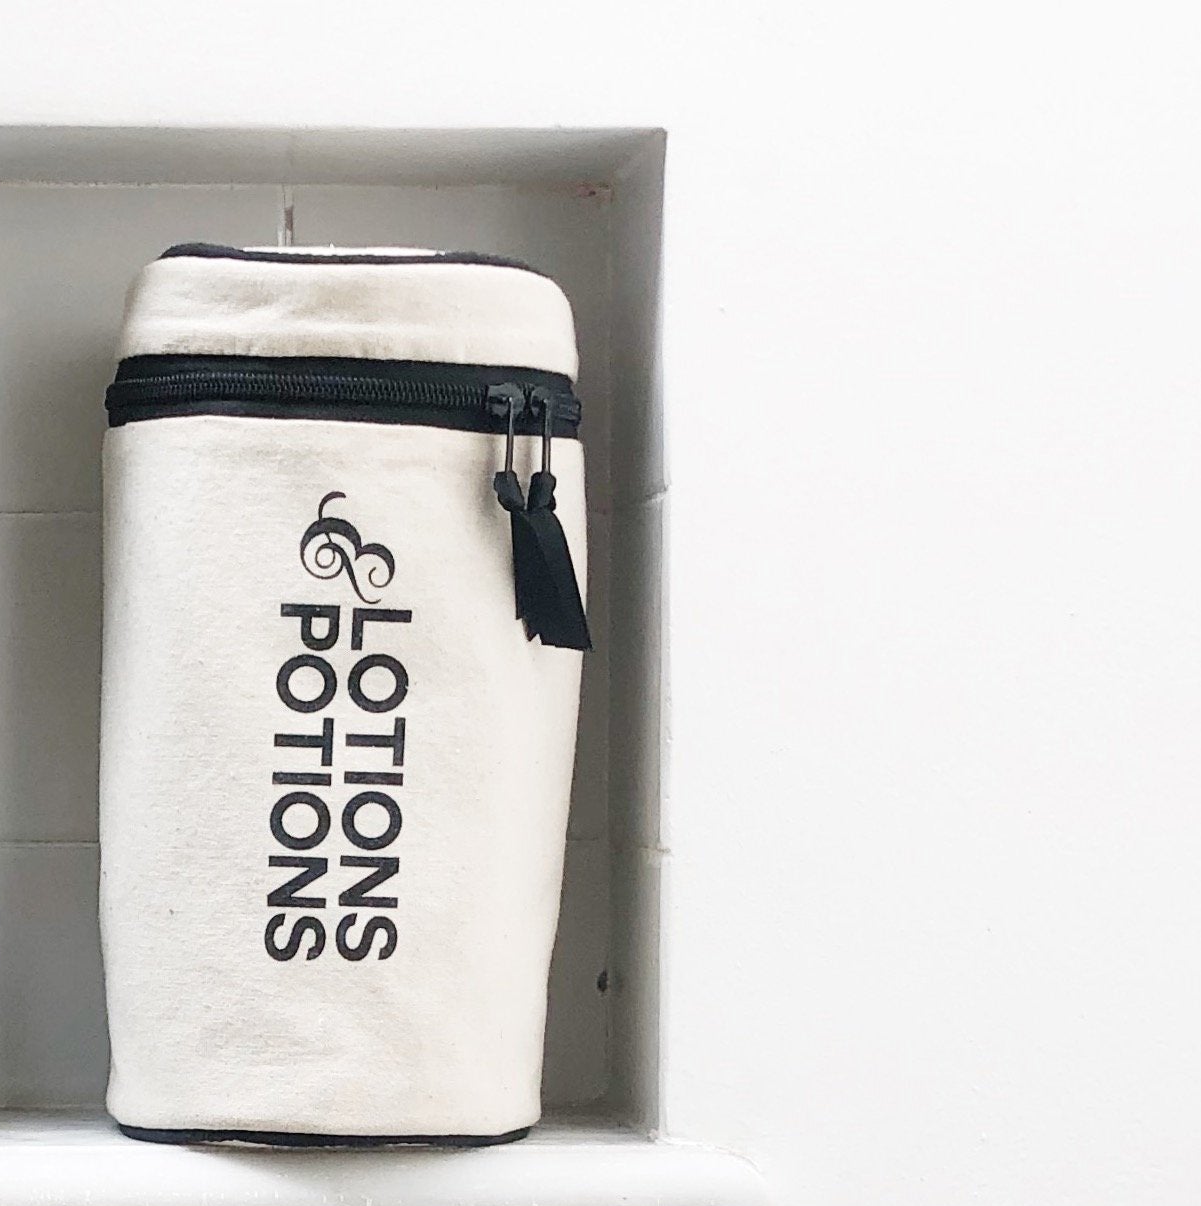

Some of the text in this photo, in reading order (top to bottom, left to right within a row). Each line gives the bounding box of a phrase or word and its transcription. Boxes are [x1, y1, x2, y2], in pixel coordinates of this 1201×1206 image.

[265, 491, 395, 961] & POTIONS
[335, 608, 412, 961] LOTIONS
